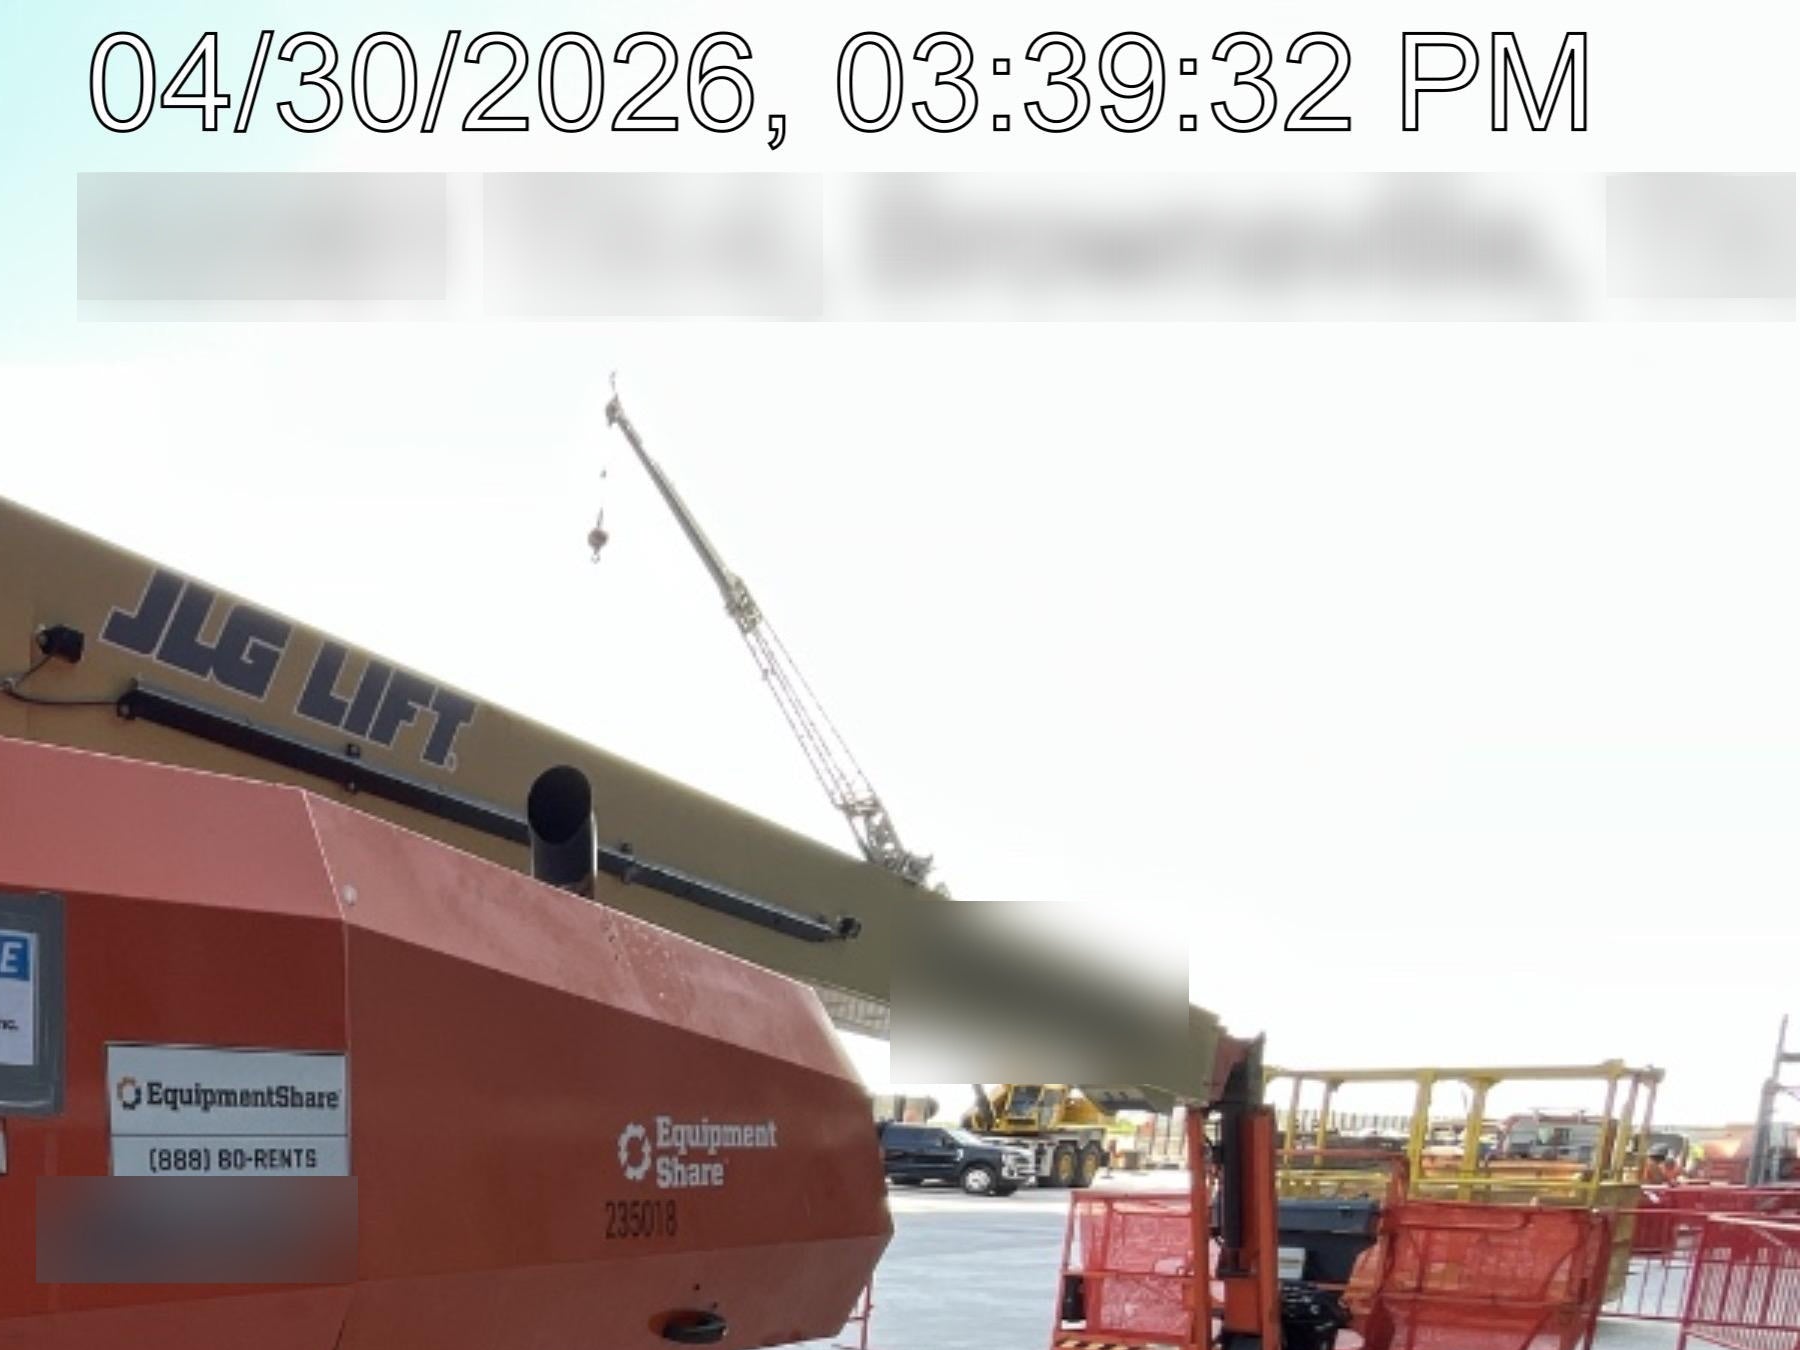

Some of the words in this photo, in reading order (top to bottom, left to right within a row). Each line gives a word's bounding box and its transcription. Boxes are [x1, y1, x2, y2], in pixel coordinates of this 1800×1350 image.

[99, 568, 296, 702] JLG
[294, 640, 479, 771] LIFT
[146, 1081, 339, 1112] EquipmentShare
[655, 1115, 777, 1156] Equipment
[149, 1148, 211, 1172] (888)
[655, 1155, 725, 1189] Share
[605, 1200, 677, 1239] 235018
